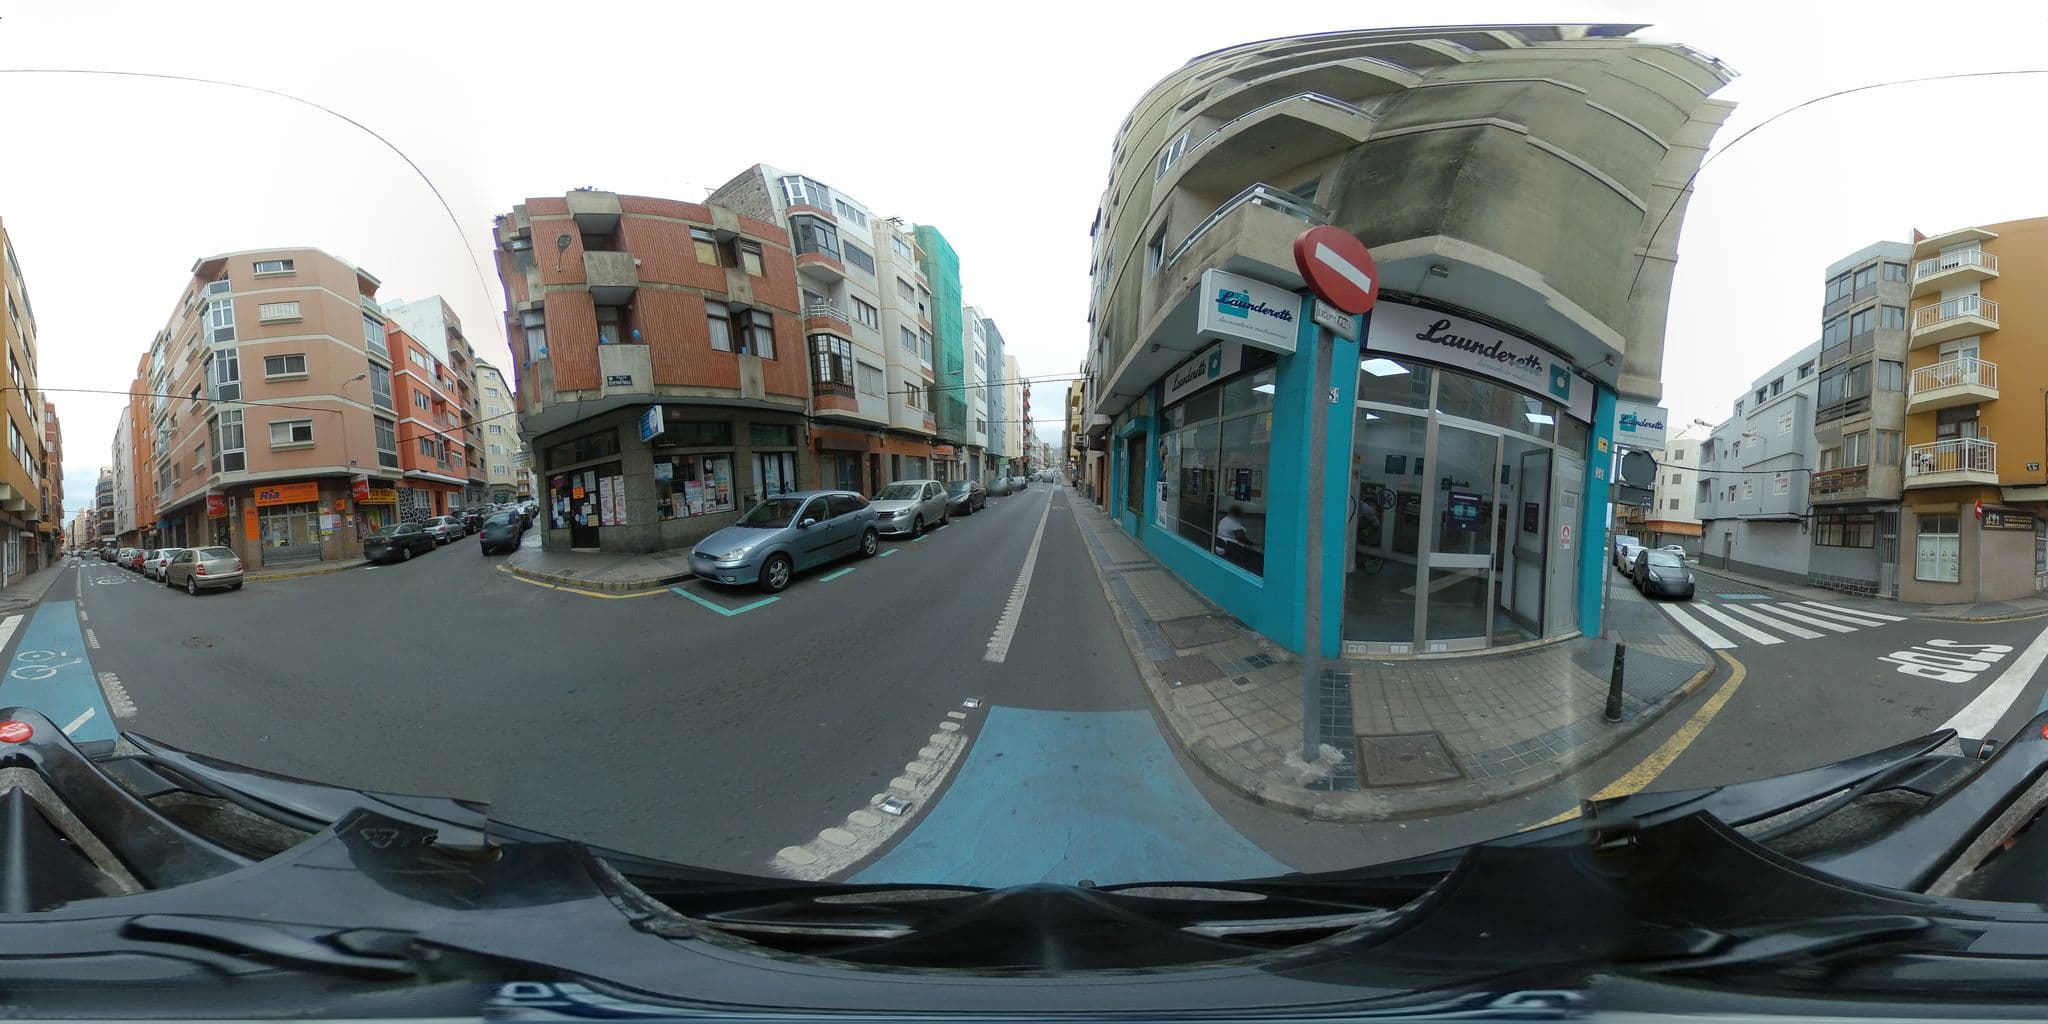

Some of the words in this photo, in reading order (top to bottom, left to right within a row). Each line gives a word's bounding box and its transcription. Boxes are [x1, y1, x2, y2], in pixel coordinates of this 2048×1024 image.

[1215, 291, 1293, 323] Launderette
[1416, 319, 1543, 377] Launderette
[1877, 639, 2014, 683] STOP
